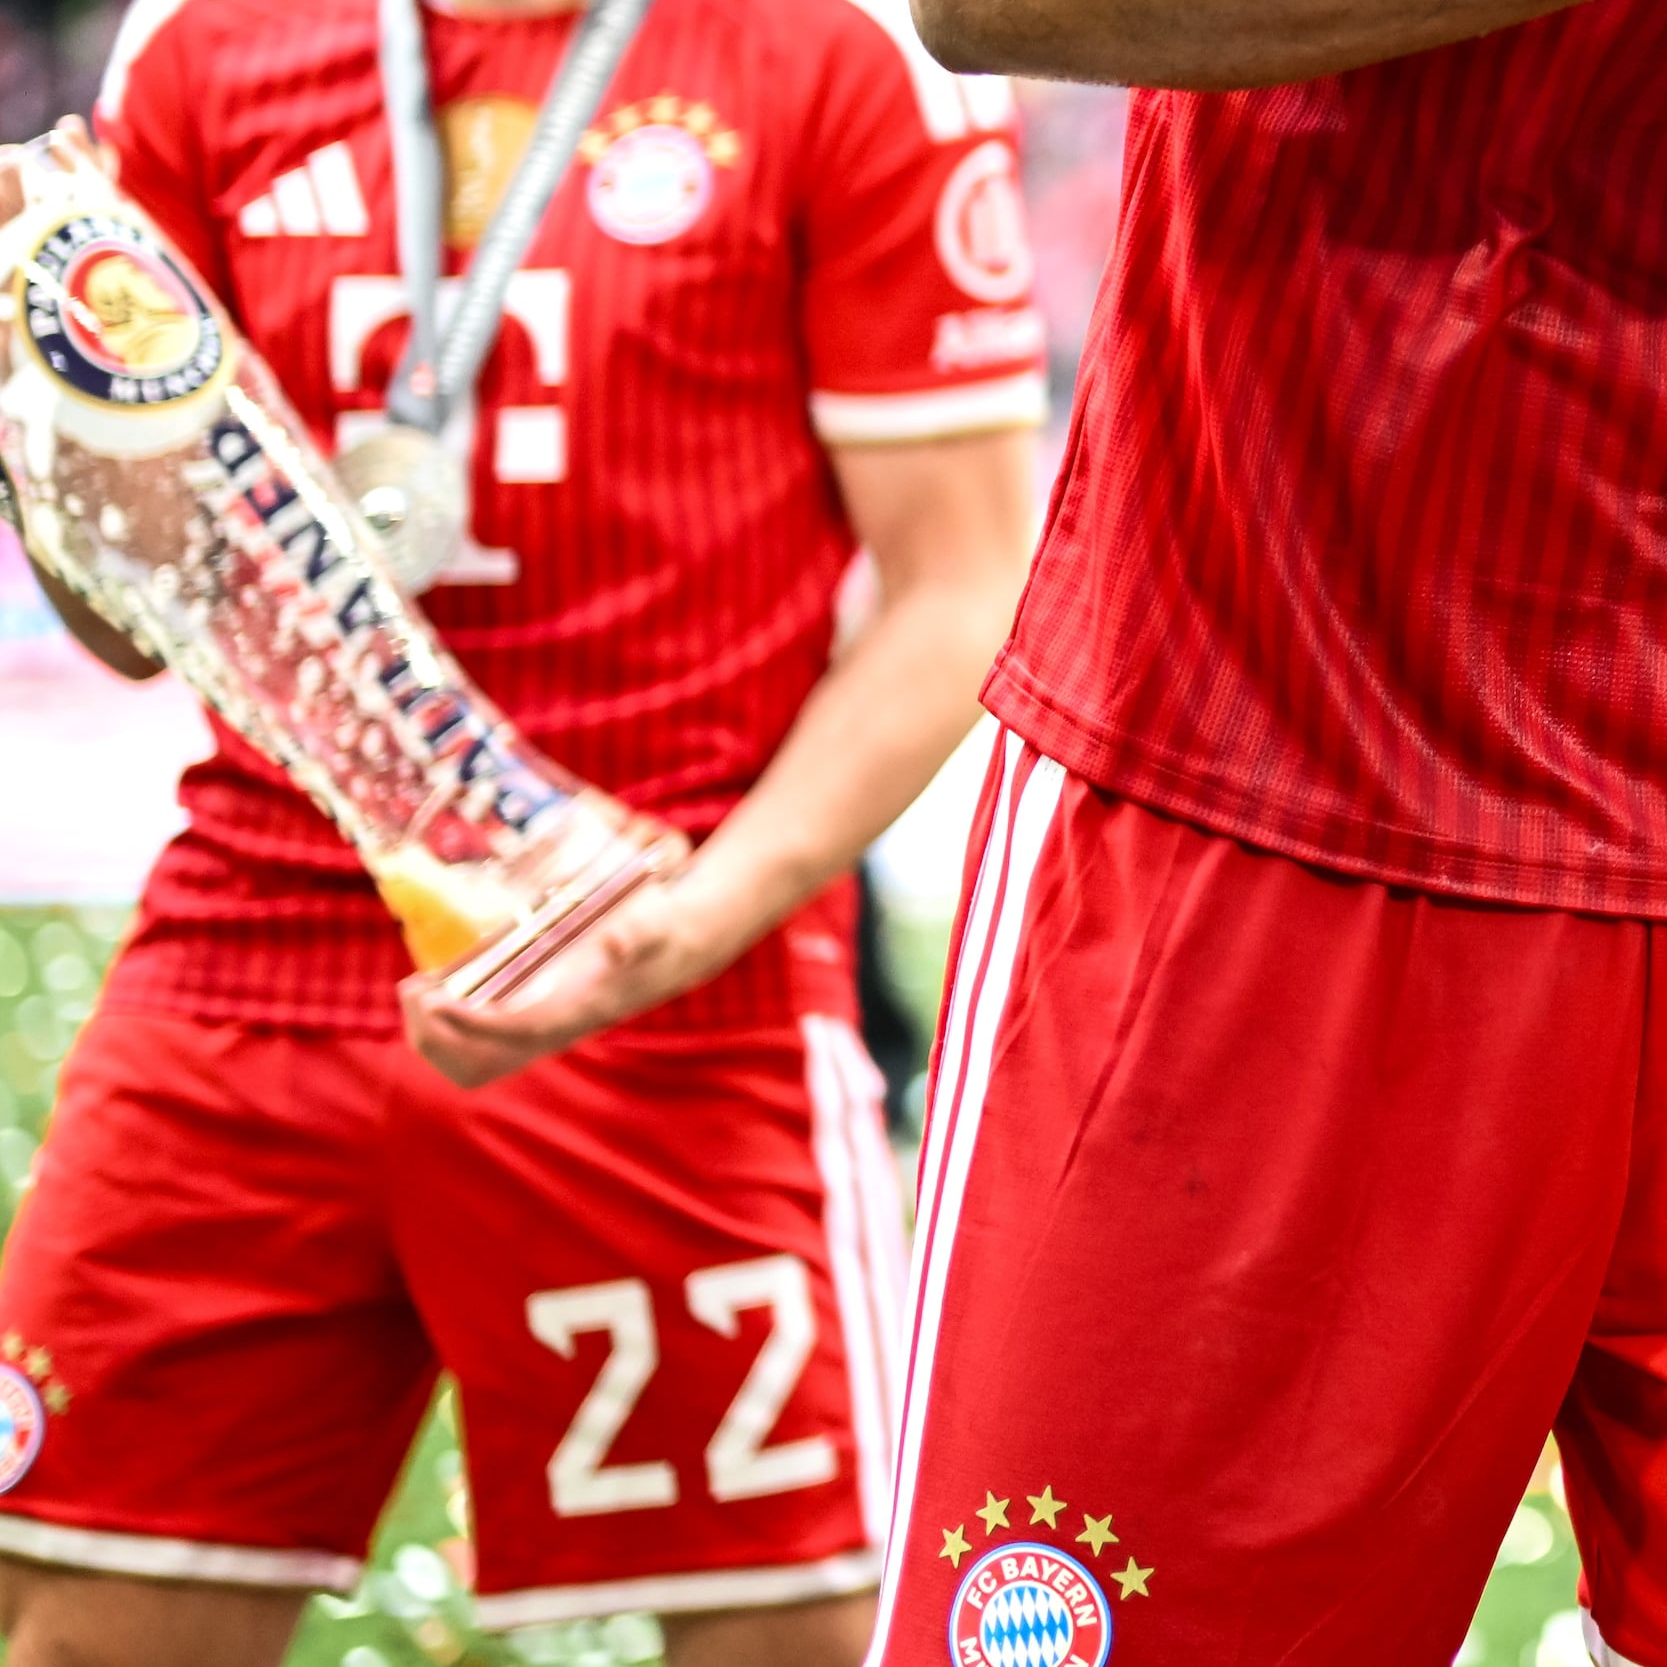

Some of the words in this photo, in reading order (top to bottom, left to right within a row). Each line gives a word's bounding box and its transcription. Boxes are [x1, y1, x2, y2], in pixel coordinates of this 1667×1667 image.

[526, 1253, 838, 1518] 22
[967, 1571, 997, 1610] FC
[1000, 1556, 1098, 1627] BAYERN
